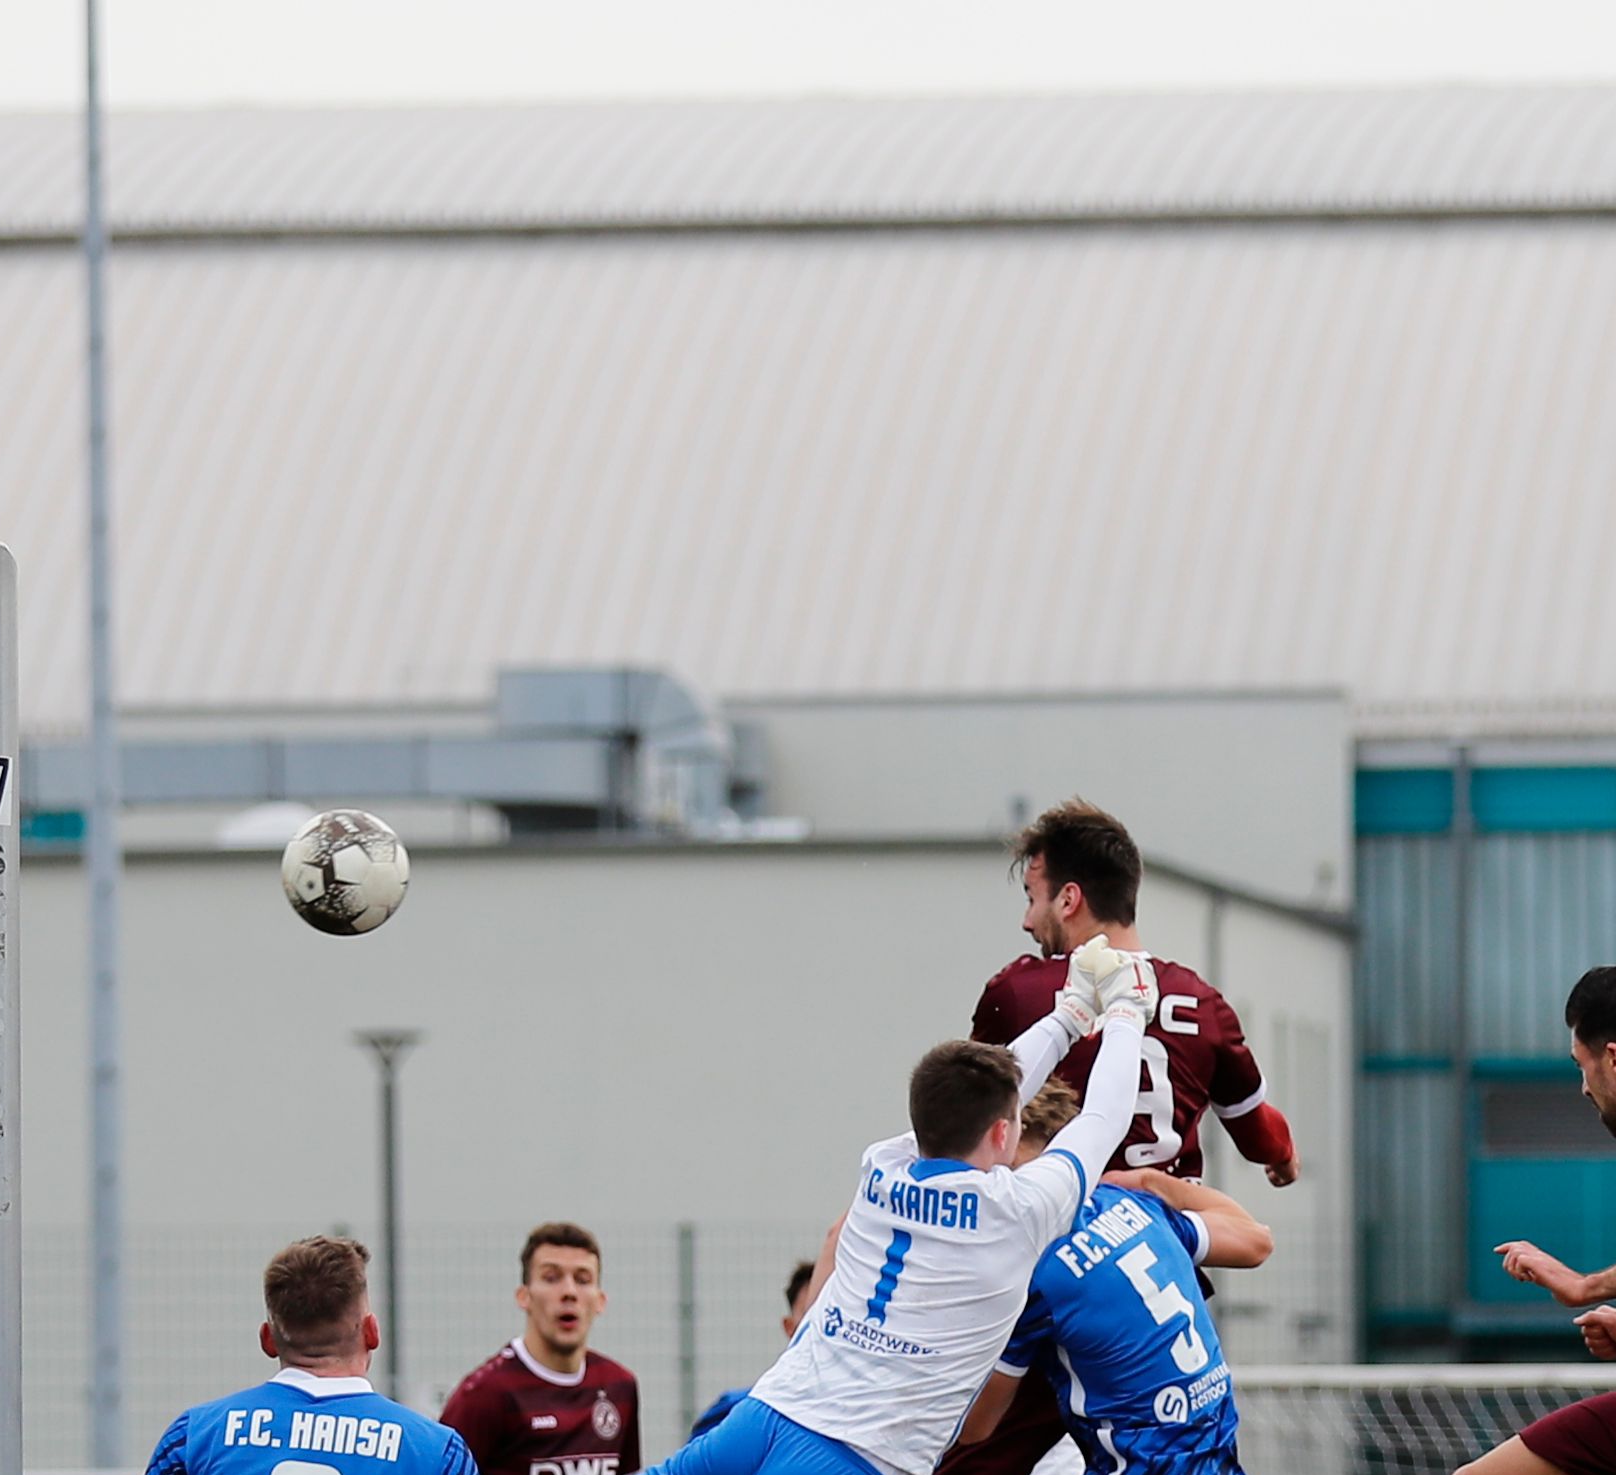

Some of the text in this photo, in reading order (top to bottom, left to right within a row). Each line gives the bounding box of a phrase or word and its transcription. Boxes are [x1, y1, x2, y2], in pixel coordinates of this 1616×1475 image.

[890, 1180, 979, 1229] HANSA
[865, 1228, 912, 1327] 1
[1055, 1231, 1111, 1279] F.C.
[1115, 1241, 1209, 1375] 5
[842, 1330, 897, 1354] ROSTO
[224, 1409, 403, 1462] F.C. HANSA
